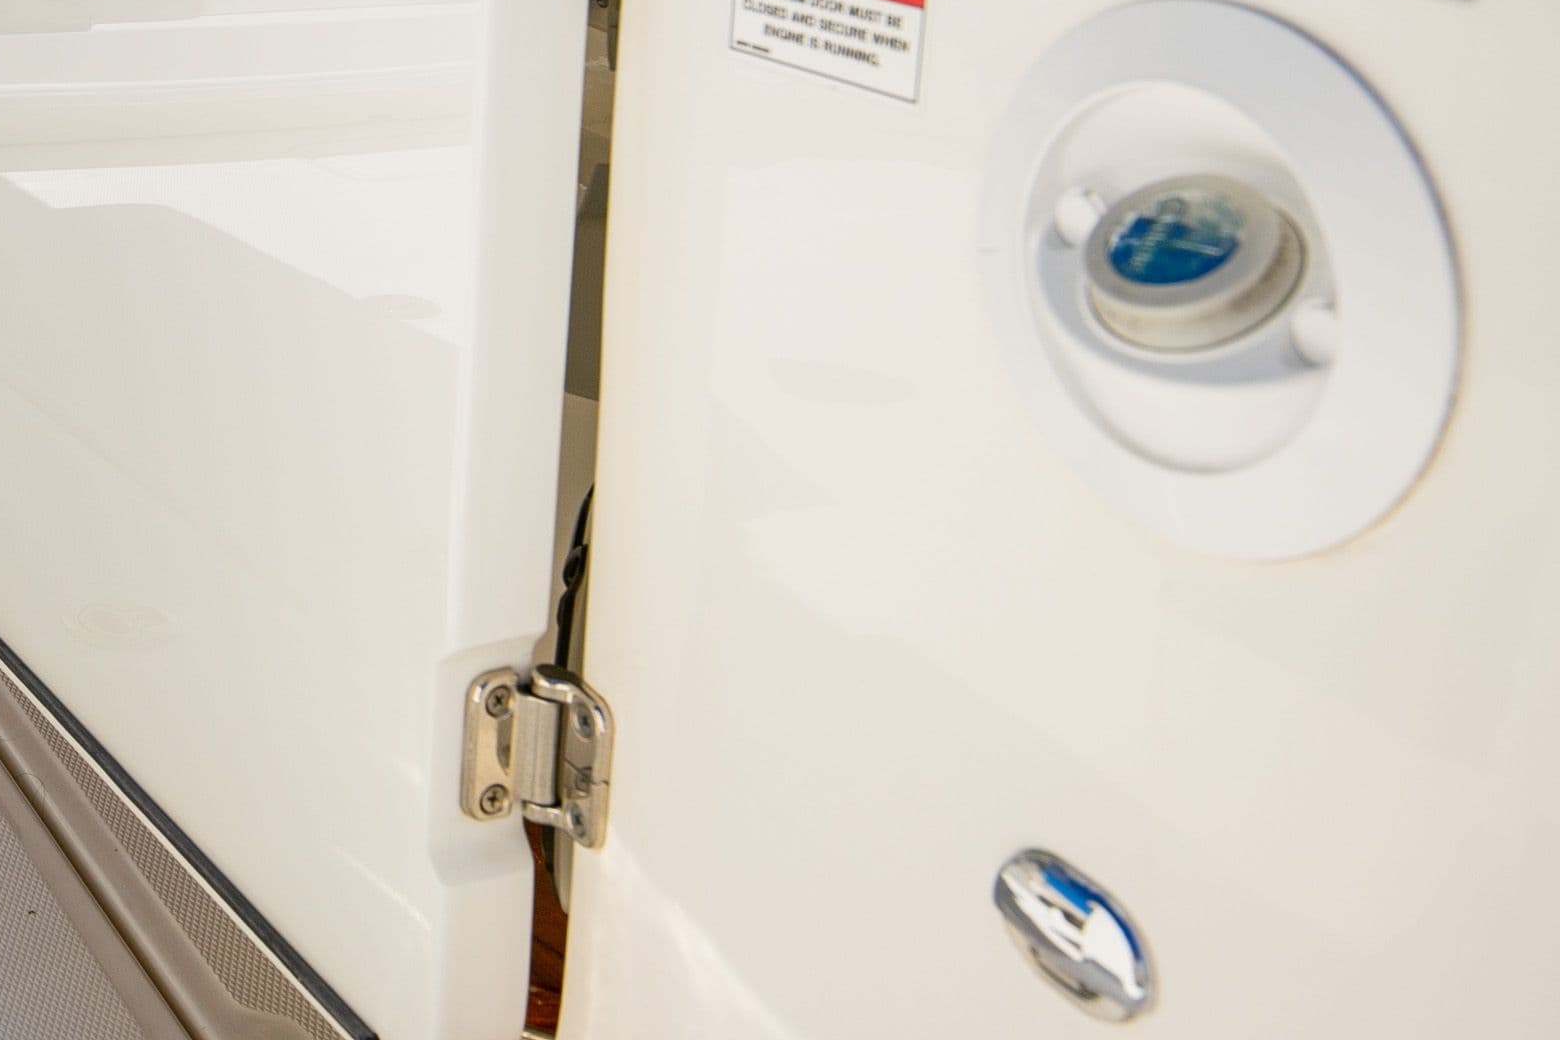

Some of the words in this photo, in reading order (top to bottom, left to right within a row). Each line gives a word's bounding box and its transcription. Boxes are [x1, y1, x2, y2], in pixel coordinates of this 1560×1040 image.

[849, 3, 883, 24] MUST
[887, 15, 902, 29] BE
[763, 23, 804, 46] ENGINE
[810, 35, 819, 49] IS
[792, 12, 816, 28] AND
[820, 18, 867, 41] SECURE
[872, 32, 910, 52] WHEN
